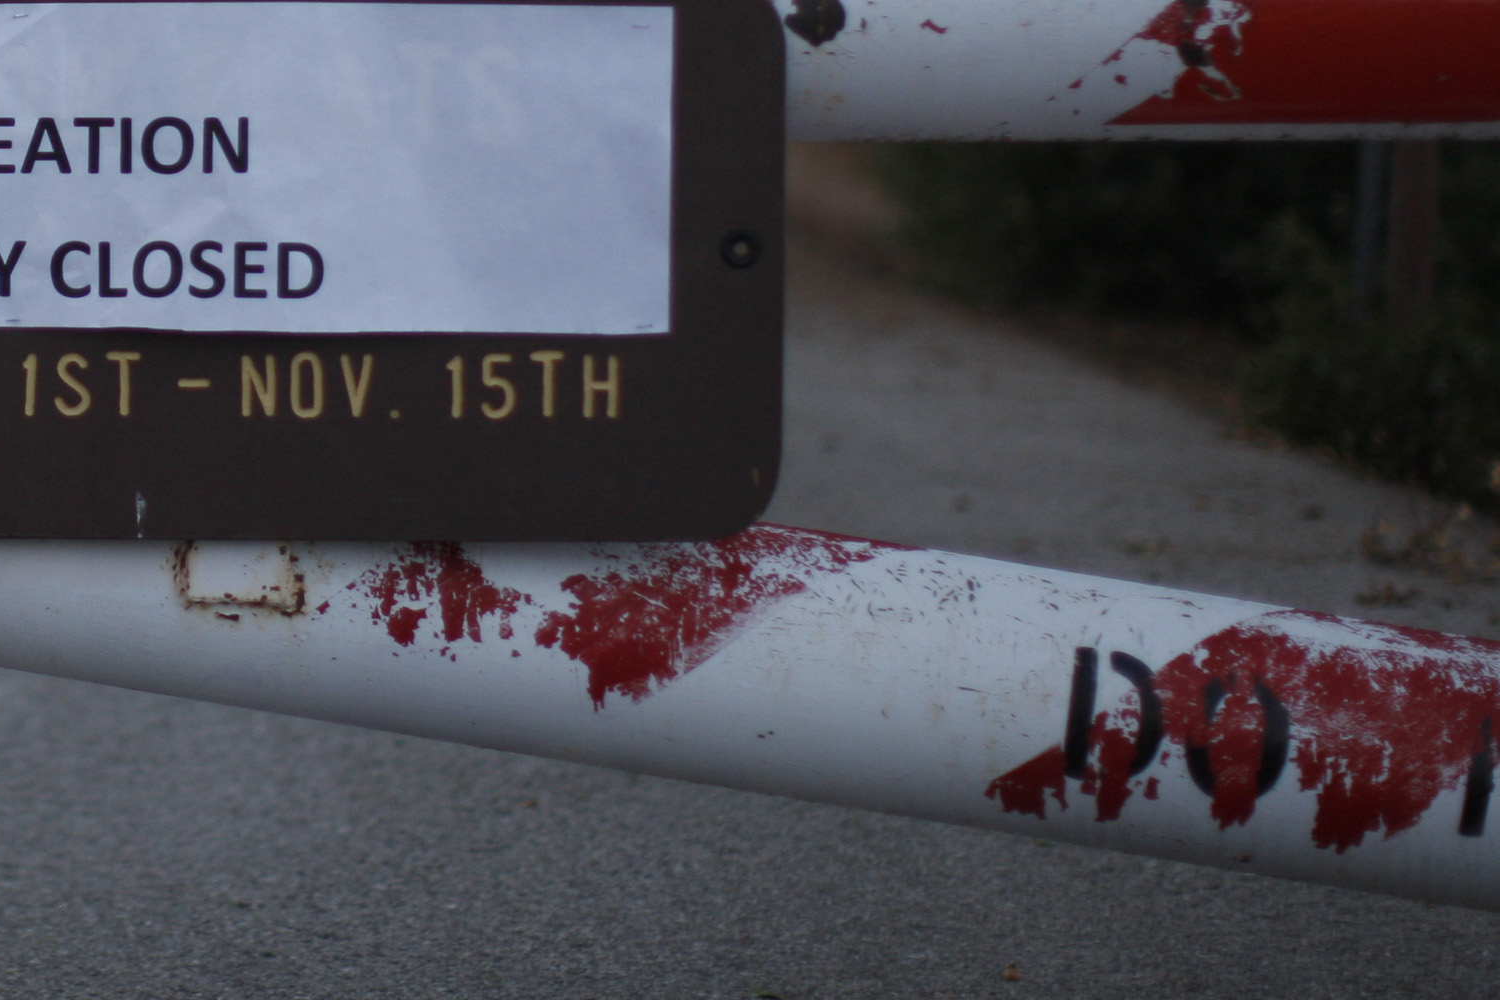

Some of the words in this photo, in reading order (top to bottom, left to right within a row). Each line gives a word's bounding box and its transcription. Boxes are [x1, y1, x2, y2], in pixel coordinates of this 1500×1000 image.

[49, 240, 325, 299] CLOSED
[22, 351, 142, 417] 1ST
[241, 352, 400, 419] NOV.
[445, 350, 619, 420] 15TH
